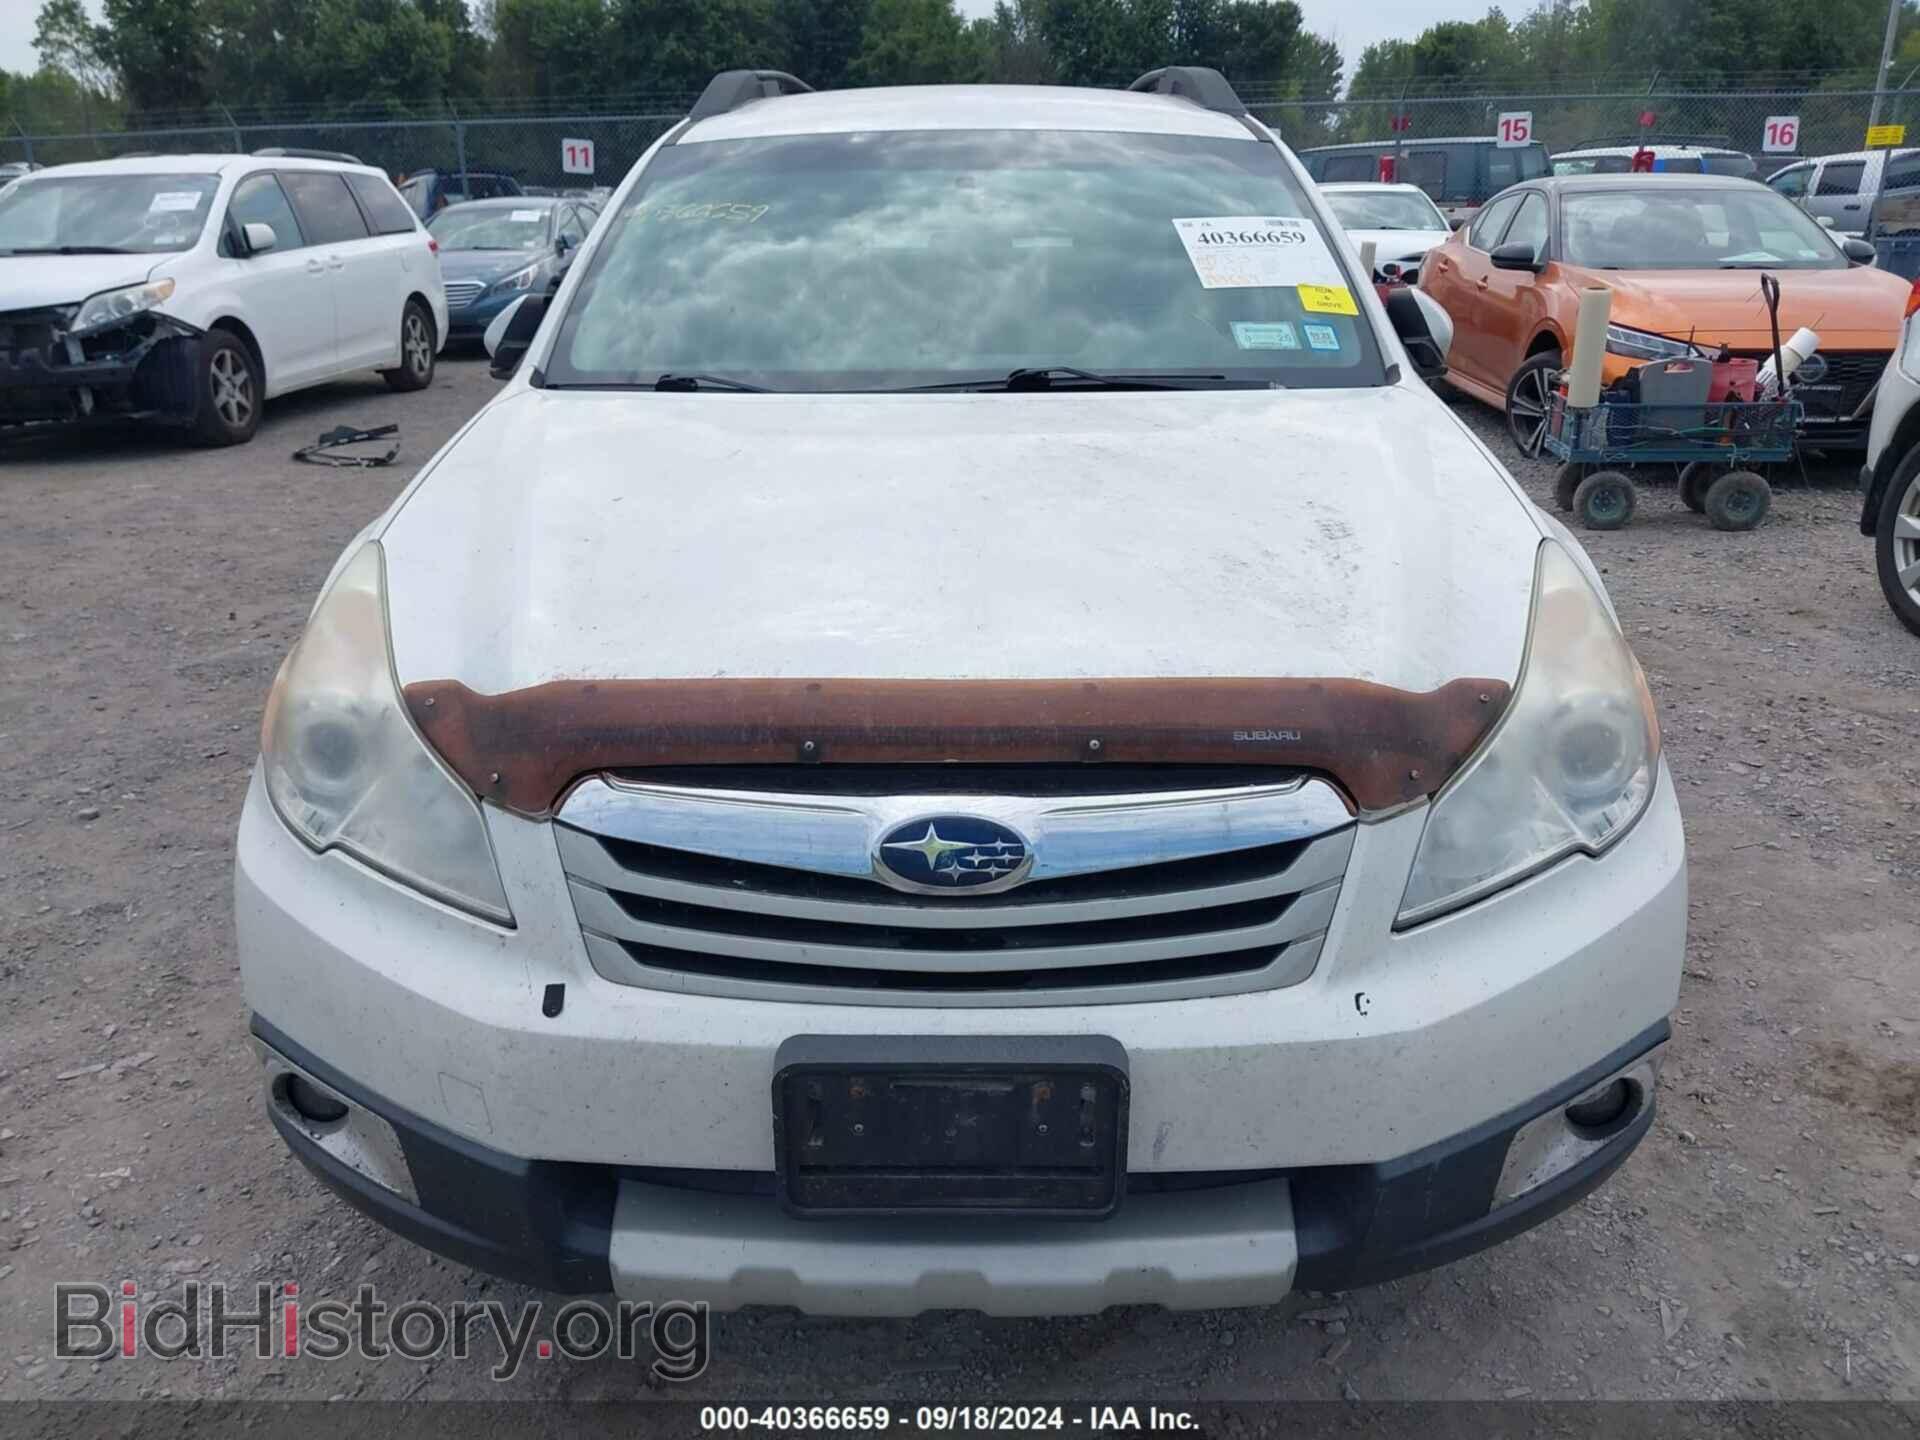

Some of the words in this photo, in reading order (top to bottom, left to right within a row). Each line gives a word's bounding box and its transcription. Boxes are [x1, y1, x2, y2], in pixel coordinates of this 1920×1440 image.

[1501, 118, 1528, 141] 15
[1767, 122, 1794, 145] 16
[566, 145, 590, 168] 11
[1197, 230, 1306, 245] 40366659
[1232, 729, 1302, 742] SUBARU
